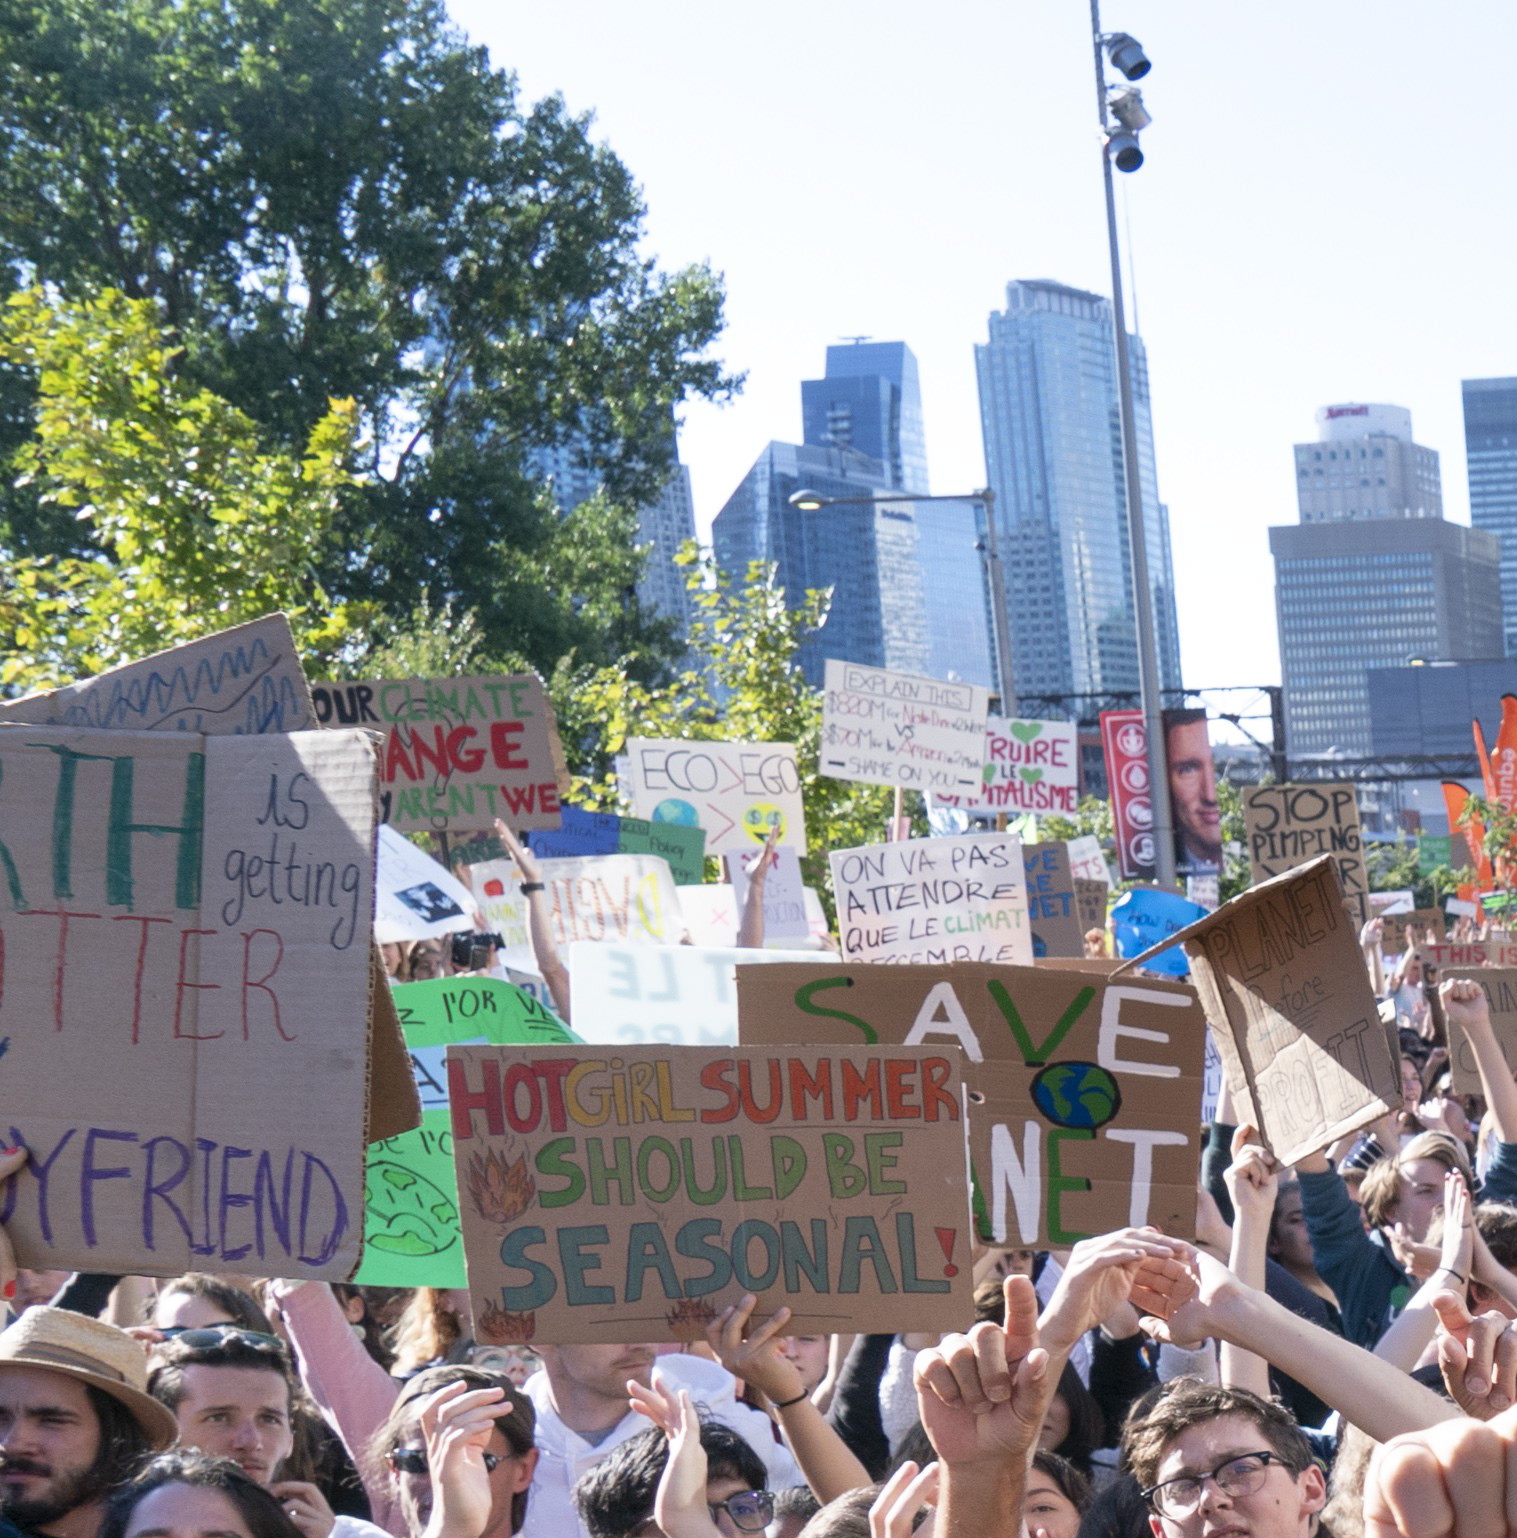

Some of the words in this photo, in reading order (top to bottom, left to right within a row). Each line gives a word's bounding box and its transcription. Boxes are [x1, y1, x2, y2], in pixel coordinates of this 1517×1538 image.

[849, 671, 920, 699] EXPLAIN
[925, 686, 964, 707] THIS
[894, 723, 915, 740] VS
[986, 731, 1070, 768] RUIRE
[641, 749, 718, 793] ECO
[740, 752, 800, 797] EGO
[849, 757, 894, 779] SHAME
[898, 764, 922, 782] ON
[929, 769, 957, 788] YOU
[1001, 765, 1017, 780] LE
[501, 784, 561, 816] WE
[1249, 787, 1353, 833] STOP
[0, 743, 206, 912] TH
[256, 762, 311, 831] is
[1252, 824, 1360, 863] PIMPING
[840, 853, 885, 885] ON
[899, 846, 937, 880] VA
[951, 844, 1010, 872] PAS
[223, 843, 361, 951] getting
[845, 924, 898, 953] QUE
[909, 915, 939, 940] LE
[1204, 862, 1338, 994] PLANET
[0, 911, 297, 1045] TTER
[1427, 945, 1487, 964] THIS
[794, 976, 1193, 1079] SAVE
[449, 1057, 578, 1140] HOT
[699, 1057, 959, 1125] SUMMER
[1255, 1018, 1374, 1137] PROFIT
[534, 1134, 809, 1209] SHOULD
[822, 1130, 909, 1200] BE
[970, 1120, 1190, 1246] NET
[499, 1211, 958, 1312] SEASONAL!
